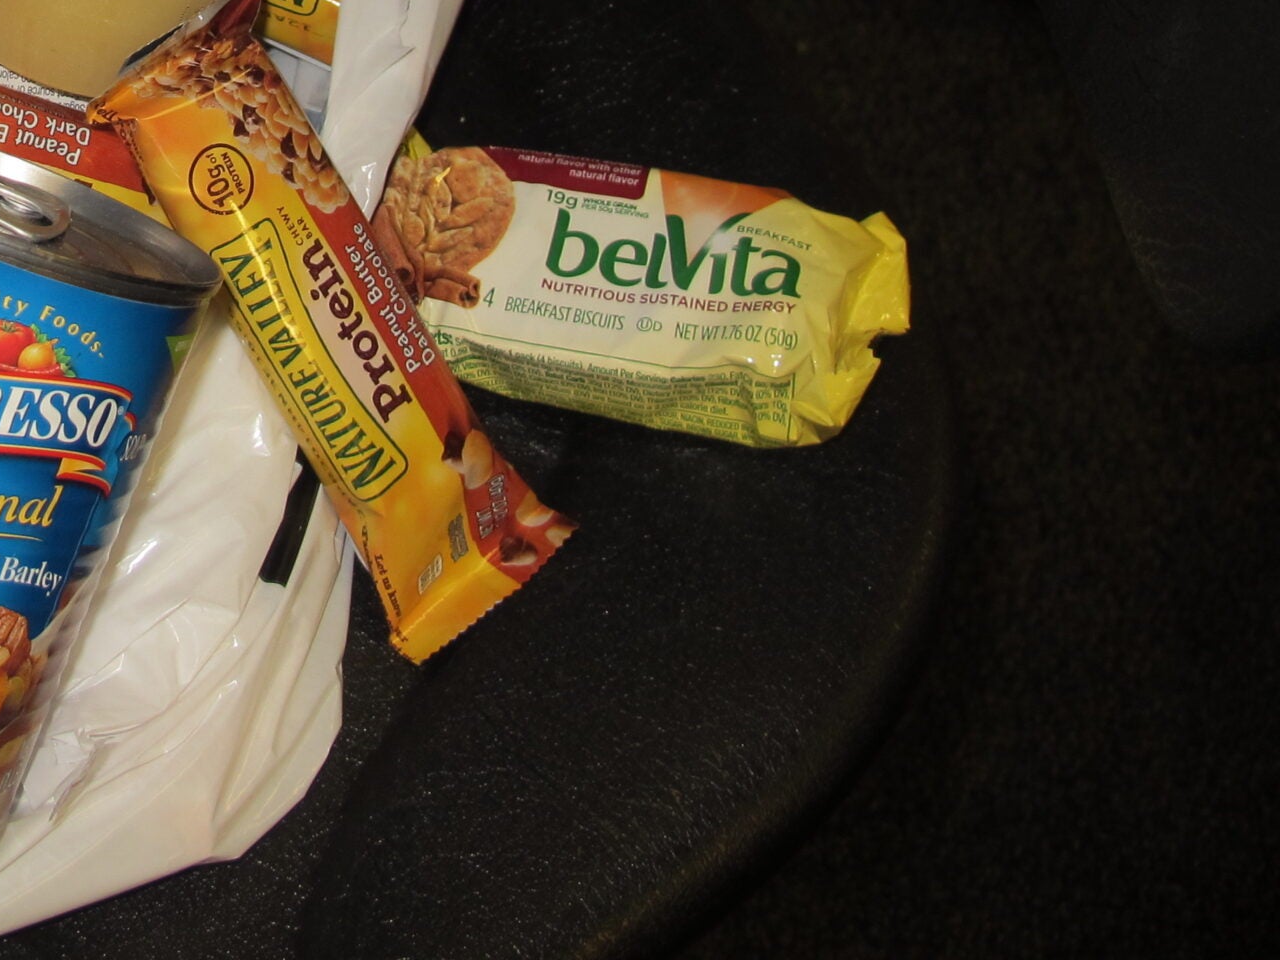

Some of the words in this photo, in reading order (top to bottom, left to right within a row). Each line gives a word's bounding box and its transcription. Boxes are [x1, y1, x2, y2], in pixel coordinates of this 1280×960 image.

[16, 132, 82, 166] Peanut
[44, 117, 92, 146] Dark
[221, 152, 246, 195] PROTEIN
[518, 154, 556, 165] natural
[588, 162, 610, 172] with
[612, 166, 643, 177] other
[569, 168, 608, 181] natural
[608, 173, 640, 186] flavor
[546, 189, 579, 210] 19g
[581, 203, 598, 212] PER
[614, 206, 649, 219] SERVING
[583, 197, 612, 207] WHOLE
[277, 206, 305, 246] CHEWY
[297, 216, 314, 239] BAR
[735, 223, 813, 252] BREAKFAST
[353, 223, 407, 315] Chocolate
[545, 207, 801, 299] belVita
[344, 244, 383, 305] Butter
[220, 238, 305, 367] VALLEY
[540, 278, 636, 305] NUTRITIOUS
[638, 293, 729, 314] SUSTAINED
[731, 301, 797, 315] ENERGY
[302, 237, 413, 423] Protein
[379, 304, 421, 373] Peanut
[482, 287, 496, 308] 4
[504, 296, 572, 323] BREAKFAST
[572, 308, 625, 331] BISCUITS
[674, 322, 699, 341] NET
[700, 323, 720, 342] WT
[719, 324, 743, 341] 1.76
[744, 325, 762, 343] OZ
[763, 327, 799, 351] (50g)
[407, 316, 436, 367] Dark
[587, 362, 619, 377] Amount
[620, 366, 635, 378] Per
[288, 360, 397, 491] NATURE
[3, 557, 63, 596] Barley
